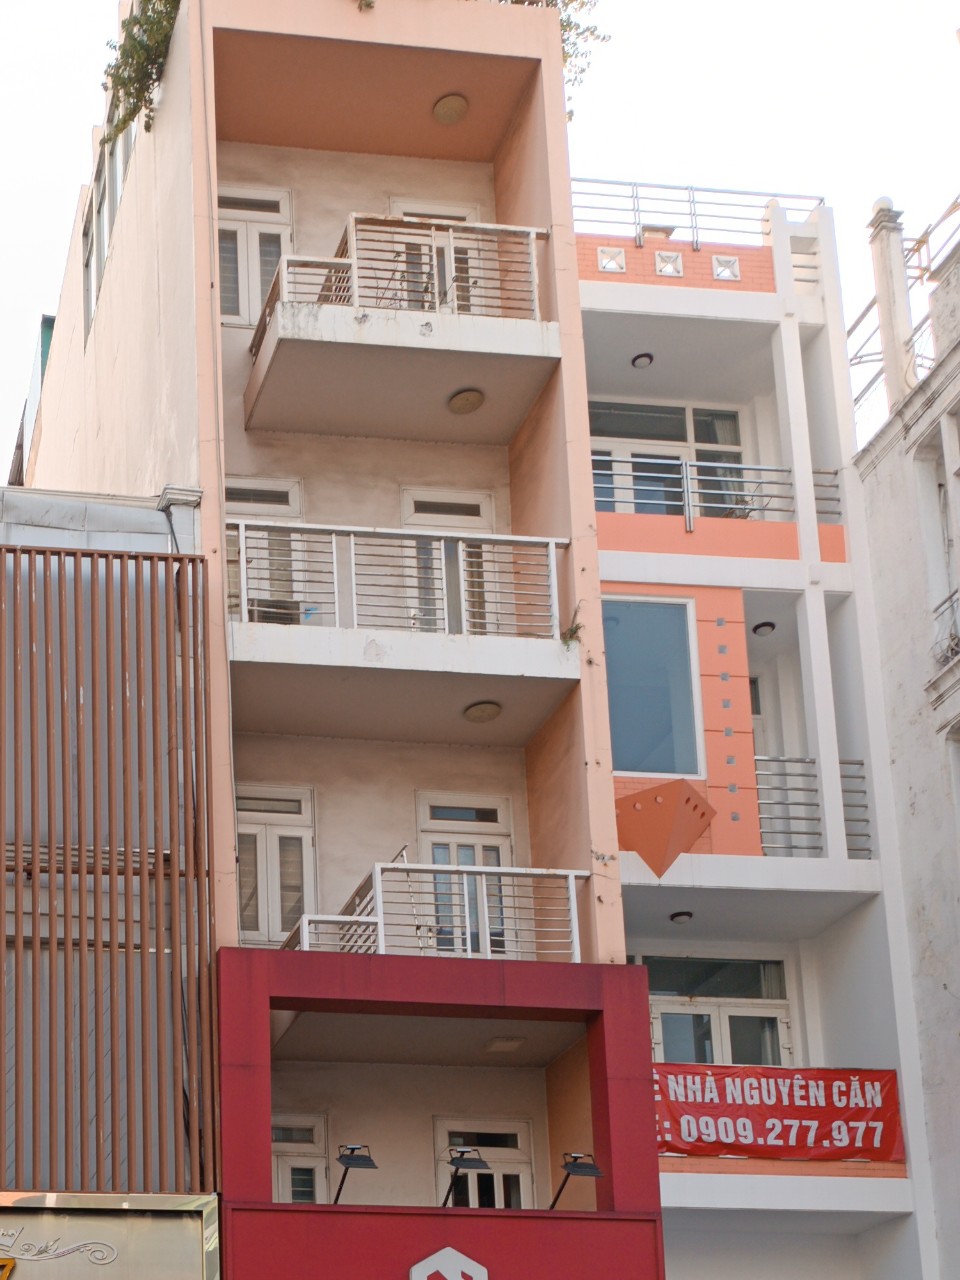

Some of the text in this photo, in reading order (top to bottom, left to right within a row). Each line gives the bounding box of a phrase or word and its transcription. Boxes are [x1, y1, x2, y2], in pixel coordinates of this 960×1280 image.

[667, 1071, 719, 1104] NHÀ
[725, 1074, 826, 1107] NGUYÊN
[832, 1076, 883, 1109] CĂN
[680, 1114, 884, 1148] 0909.277.977
